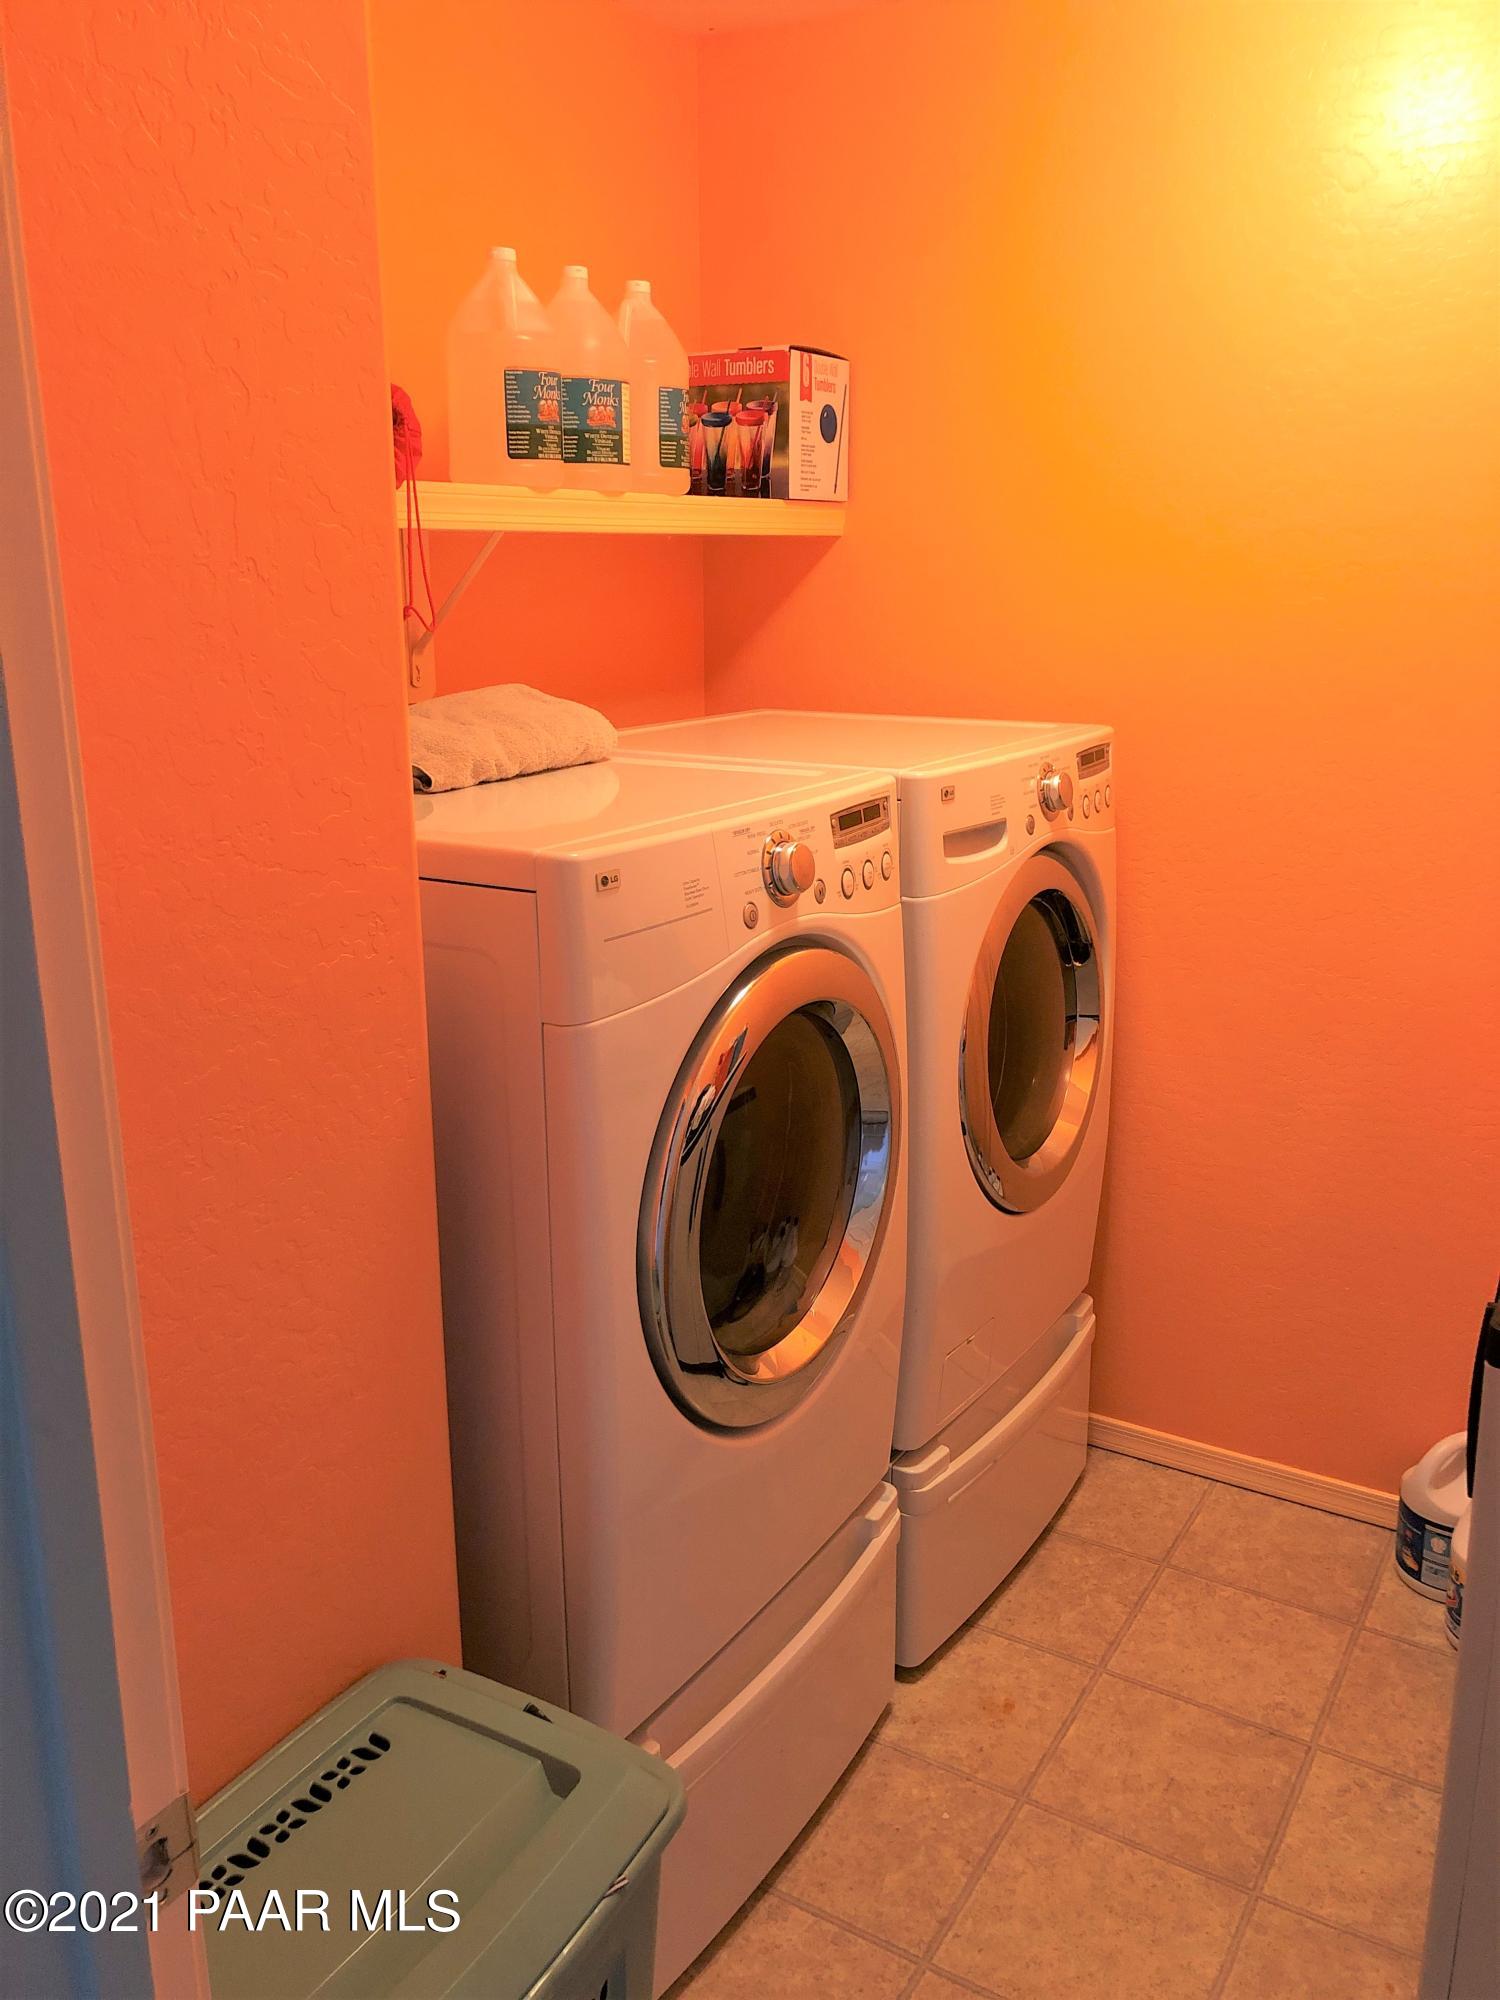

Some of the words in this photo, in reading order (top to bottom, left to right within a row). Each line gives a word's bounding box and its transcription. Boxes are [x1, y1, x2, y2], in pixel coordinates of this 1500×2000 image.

[703, 359, 720, 377] Wall
[723, 356, 775, 377] Tumblers
[802, 353, 810, 388] 6
[538, 371, 559, 386] Four
[588, 379, 615, 393] Four
[533, 384, 561, 401] Monks
[582, 391, 619, 406] Monks
[610, 875, 619, 884] LG
